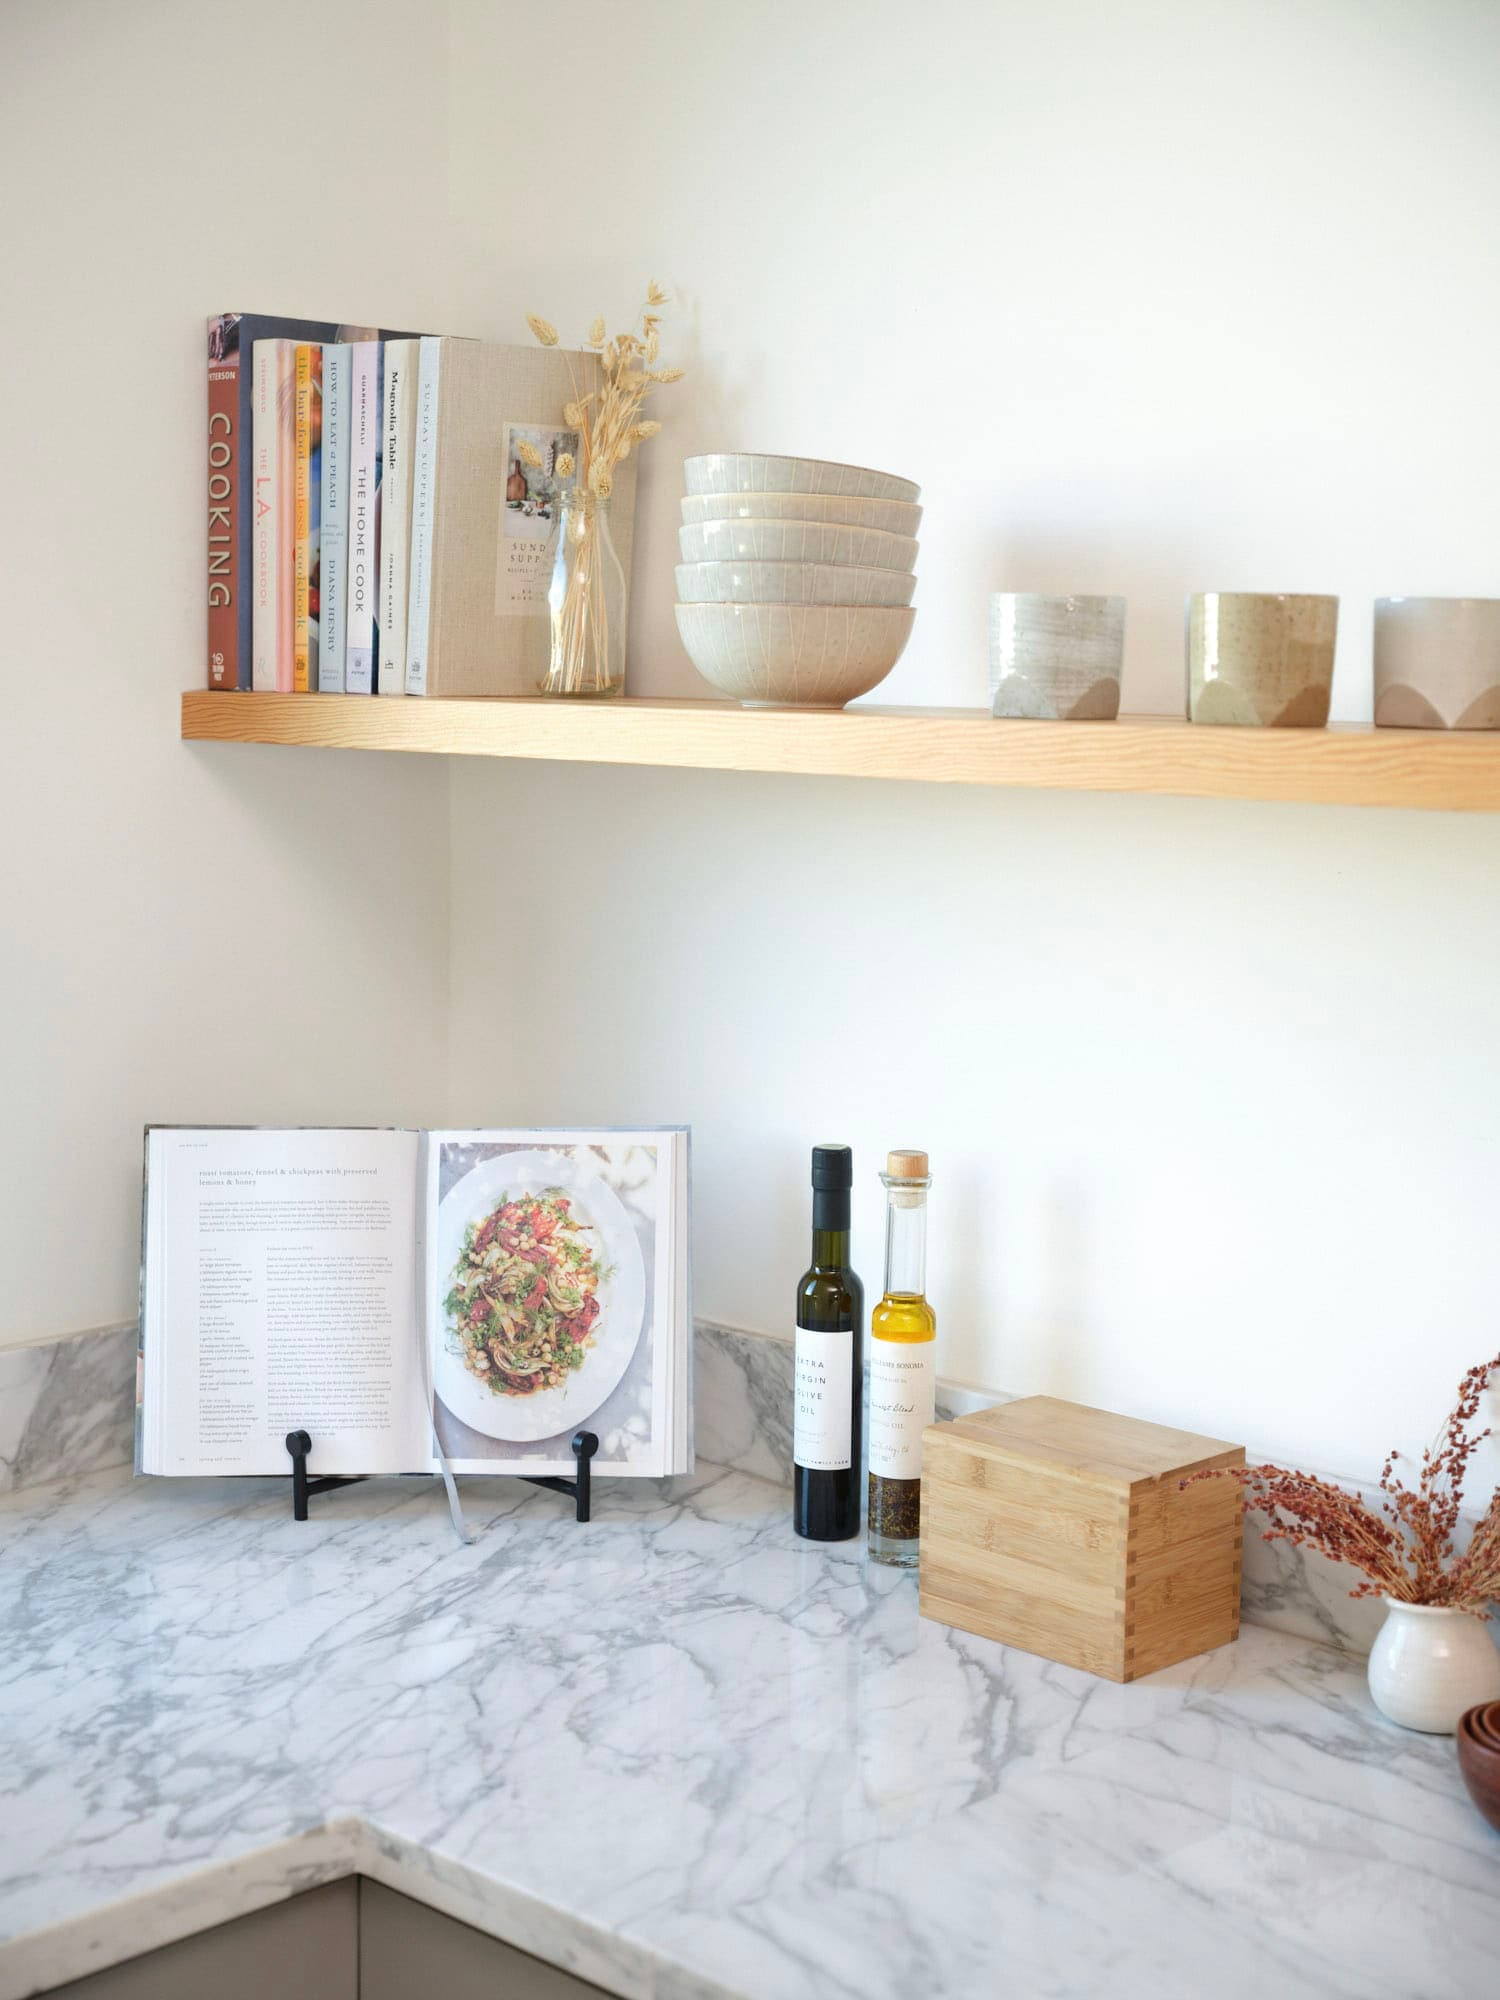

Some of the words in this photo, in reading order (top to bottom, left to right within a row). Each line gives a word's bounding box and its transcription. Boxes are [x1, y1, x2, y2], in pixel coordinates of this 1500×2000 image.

[329, 361, 338, 394] HOW
[329, 398, 338, 418] TO
[389, 370, 399, 432] Magnolia
[422, 383, 430, 444] SUNDAY
[298, 389, 308, 461] barefoot
[329, 422, 338, 448] EAT
[387, 434, 397, 470] Table
[328, 464, 337, 509] PEACH
[357, 466, 367, 499] THE
[208, 412, 233, 609] COOKING
[356, 506, 366, 557] HOME
[511, 543, 547, 553] SUND
[259, 530, 268, 608] COOKBOOK
[510, 554, 541, 563] SUPP
[296, 545, 306, 630] cookbook
[327, 559, 336, 603] DIANA
[355, 563, 365, 613] COOK
[326, 606, 336, 653] HENRY
[199, 1178, 225, 1186] lemons
[235, 1178, 257, 1188] honey
[288, 1167, 323, 1177] chickpeas
[325, 1167, 341, 1175] with
[343, 1167, 378, 1177] preserved
[896, 1361, 924, 1369] SONOMA
[800, 1405, 815, 1416] OIL
